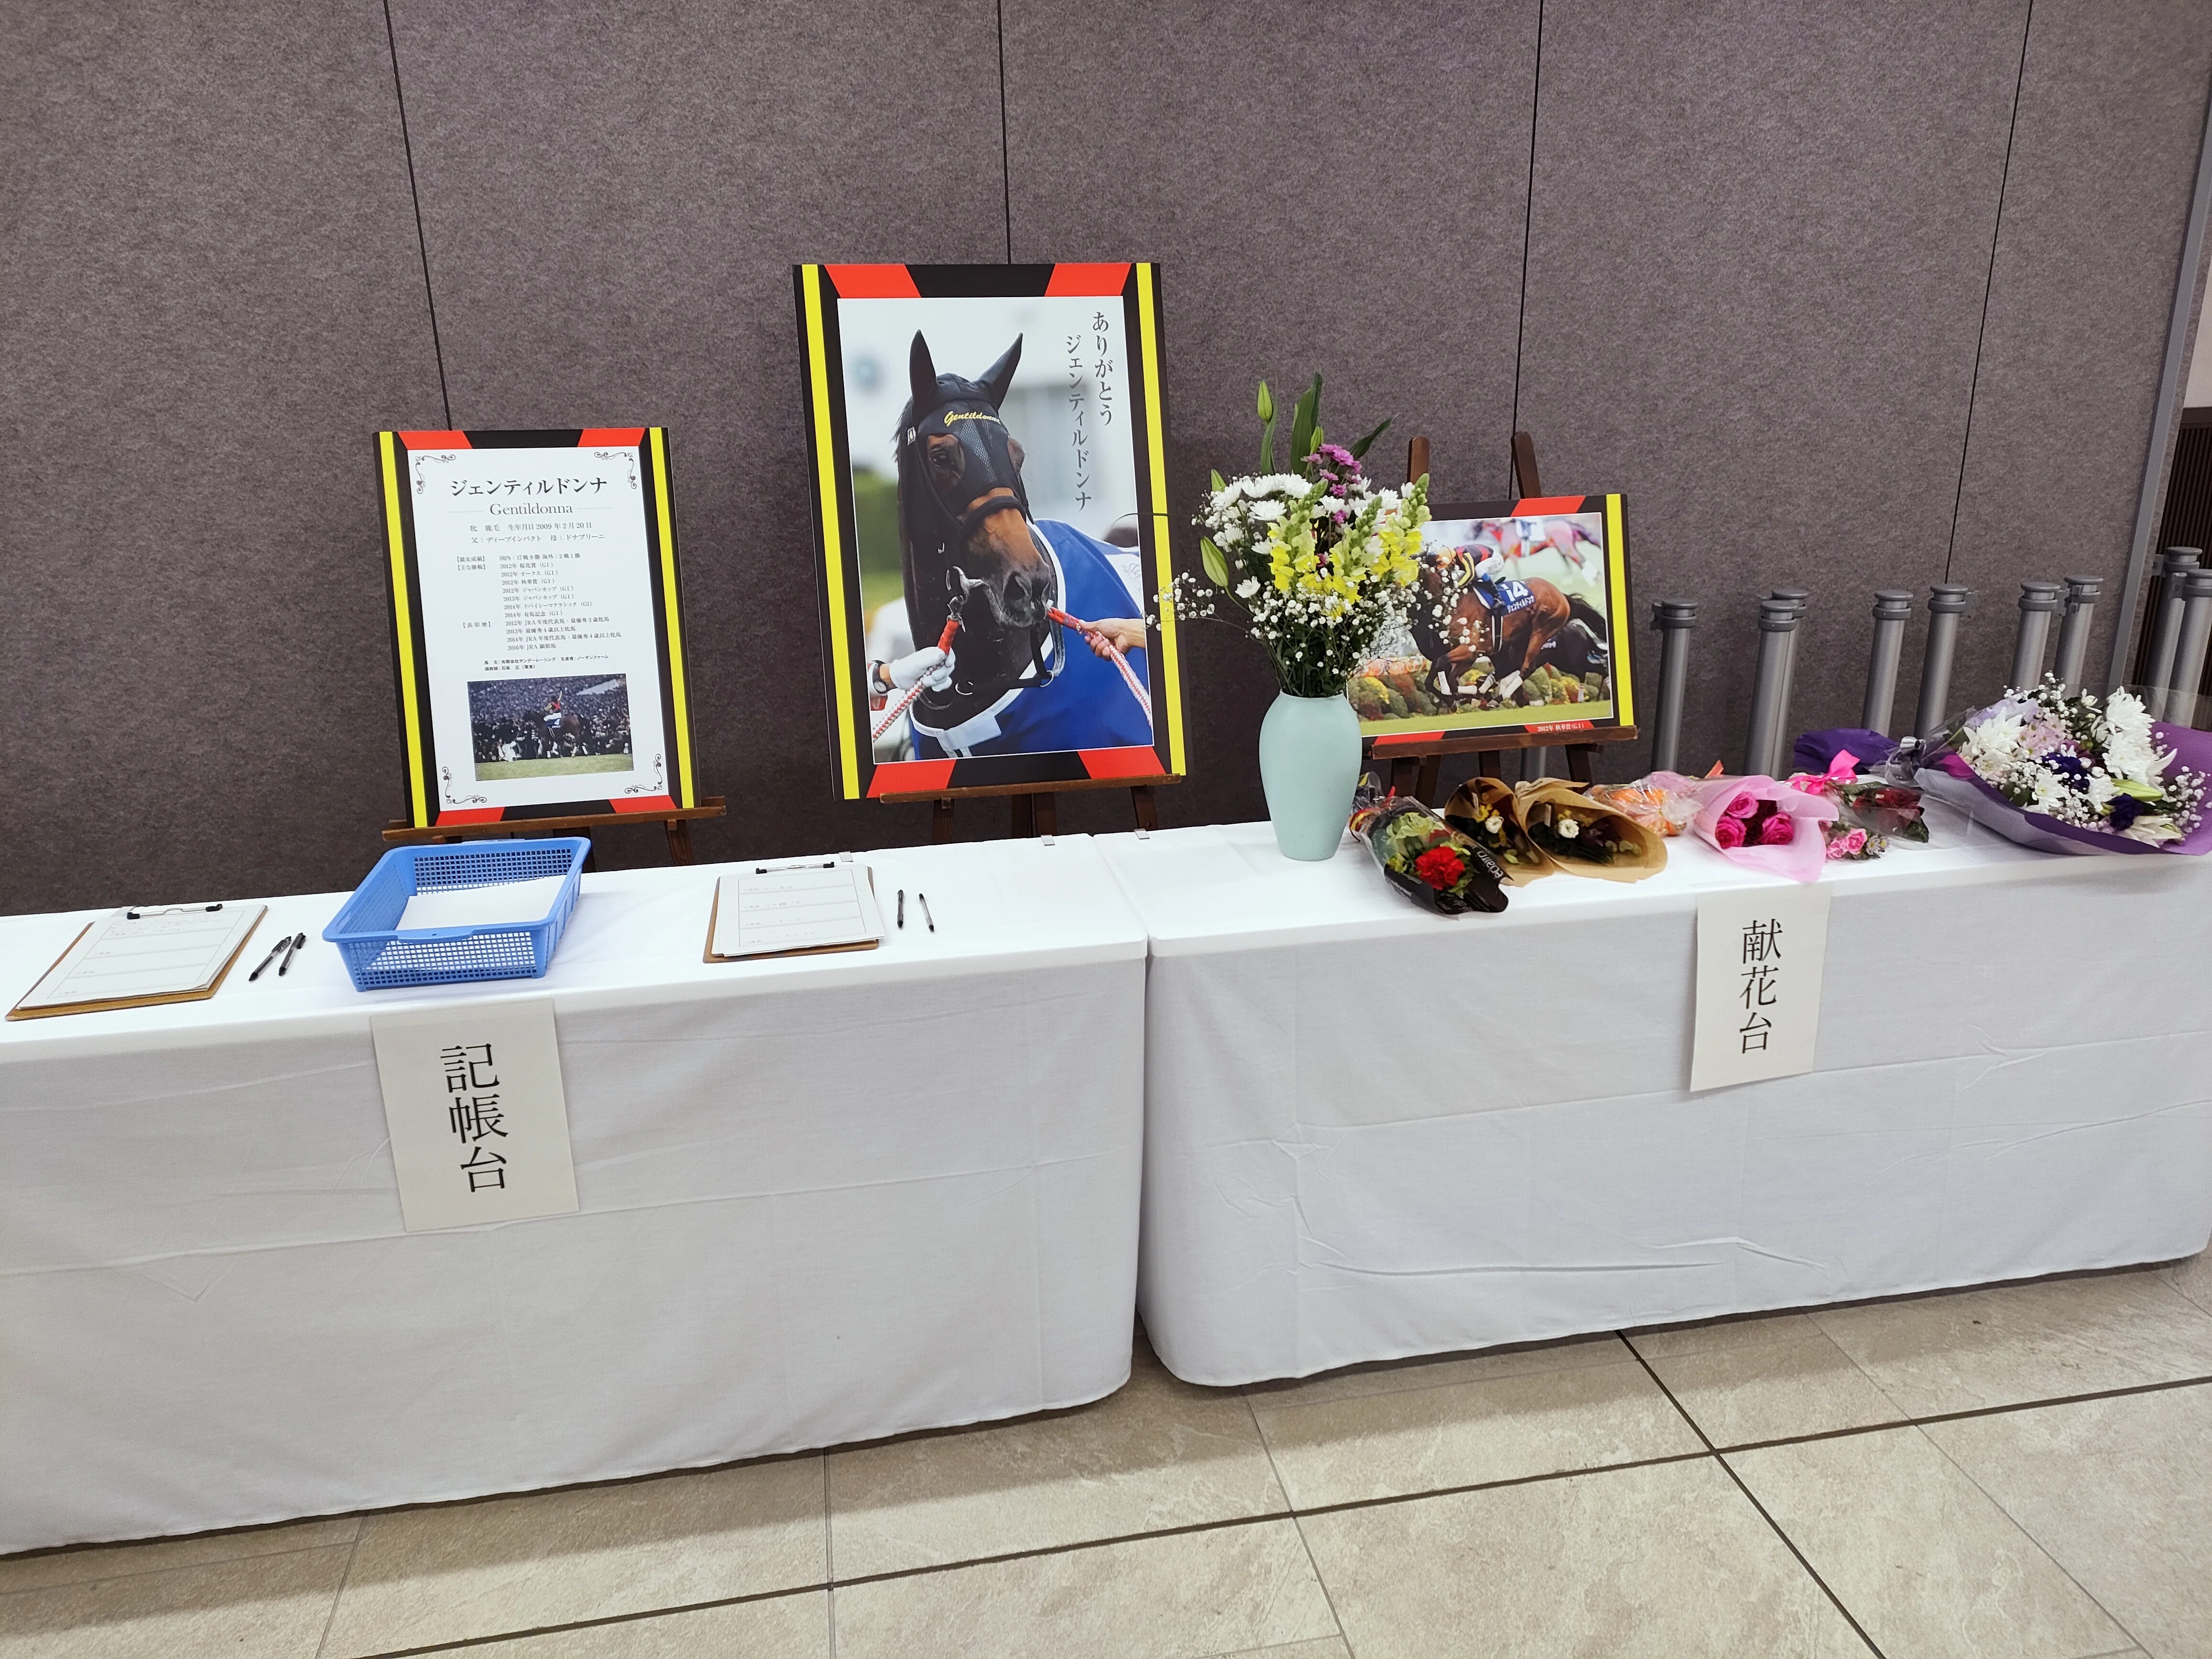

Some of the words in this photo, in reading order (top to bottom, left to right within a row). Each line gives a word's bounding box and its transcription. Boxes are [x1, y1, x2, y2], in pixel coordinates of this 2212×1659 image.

[1093, 311, 1113, 426] ありがとう
[944, 410, 1001, 427] Gentildonna
[1065, 334, 1092, 511] ジェンティルドンナ
[450, 477, 607, 496] ジェンティルドンナ
[490, 503, 574, 516] Gentildonna
[1501, 581, 1528, 602] 14
[1739, 918, 1783, 1054] 献花台
[440, 1043, 509, 1194] 記帳台
